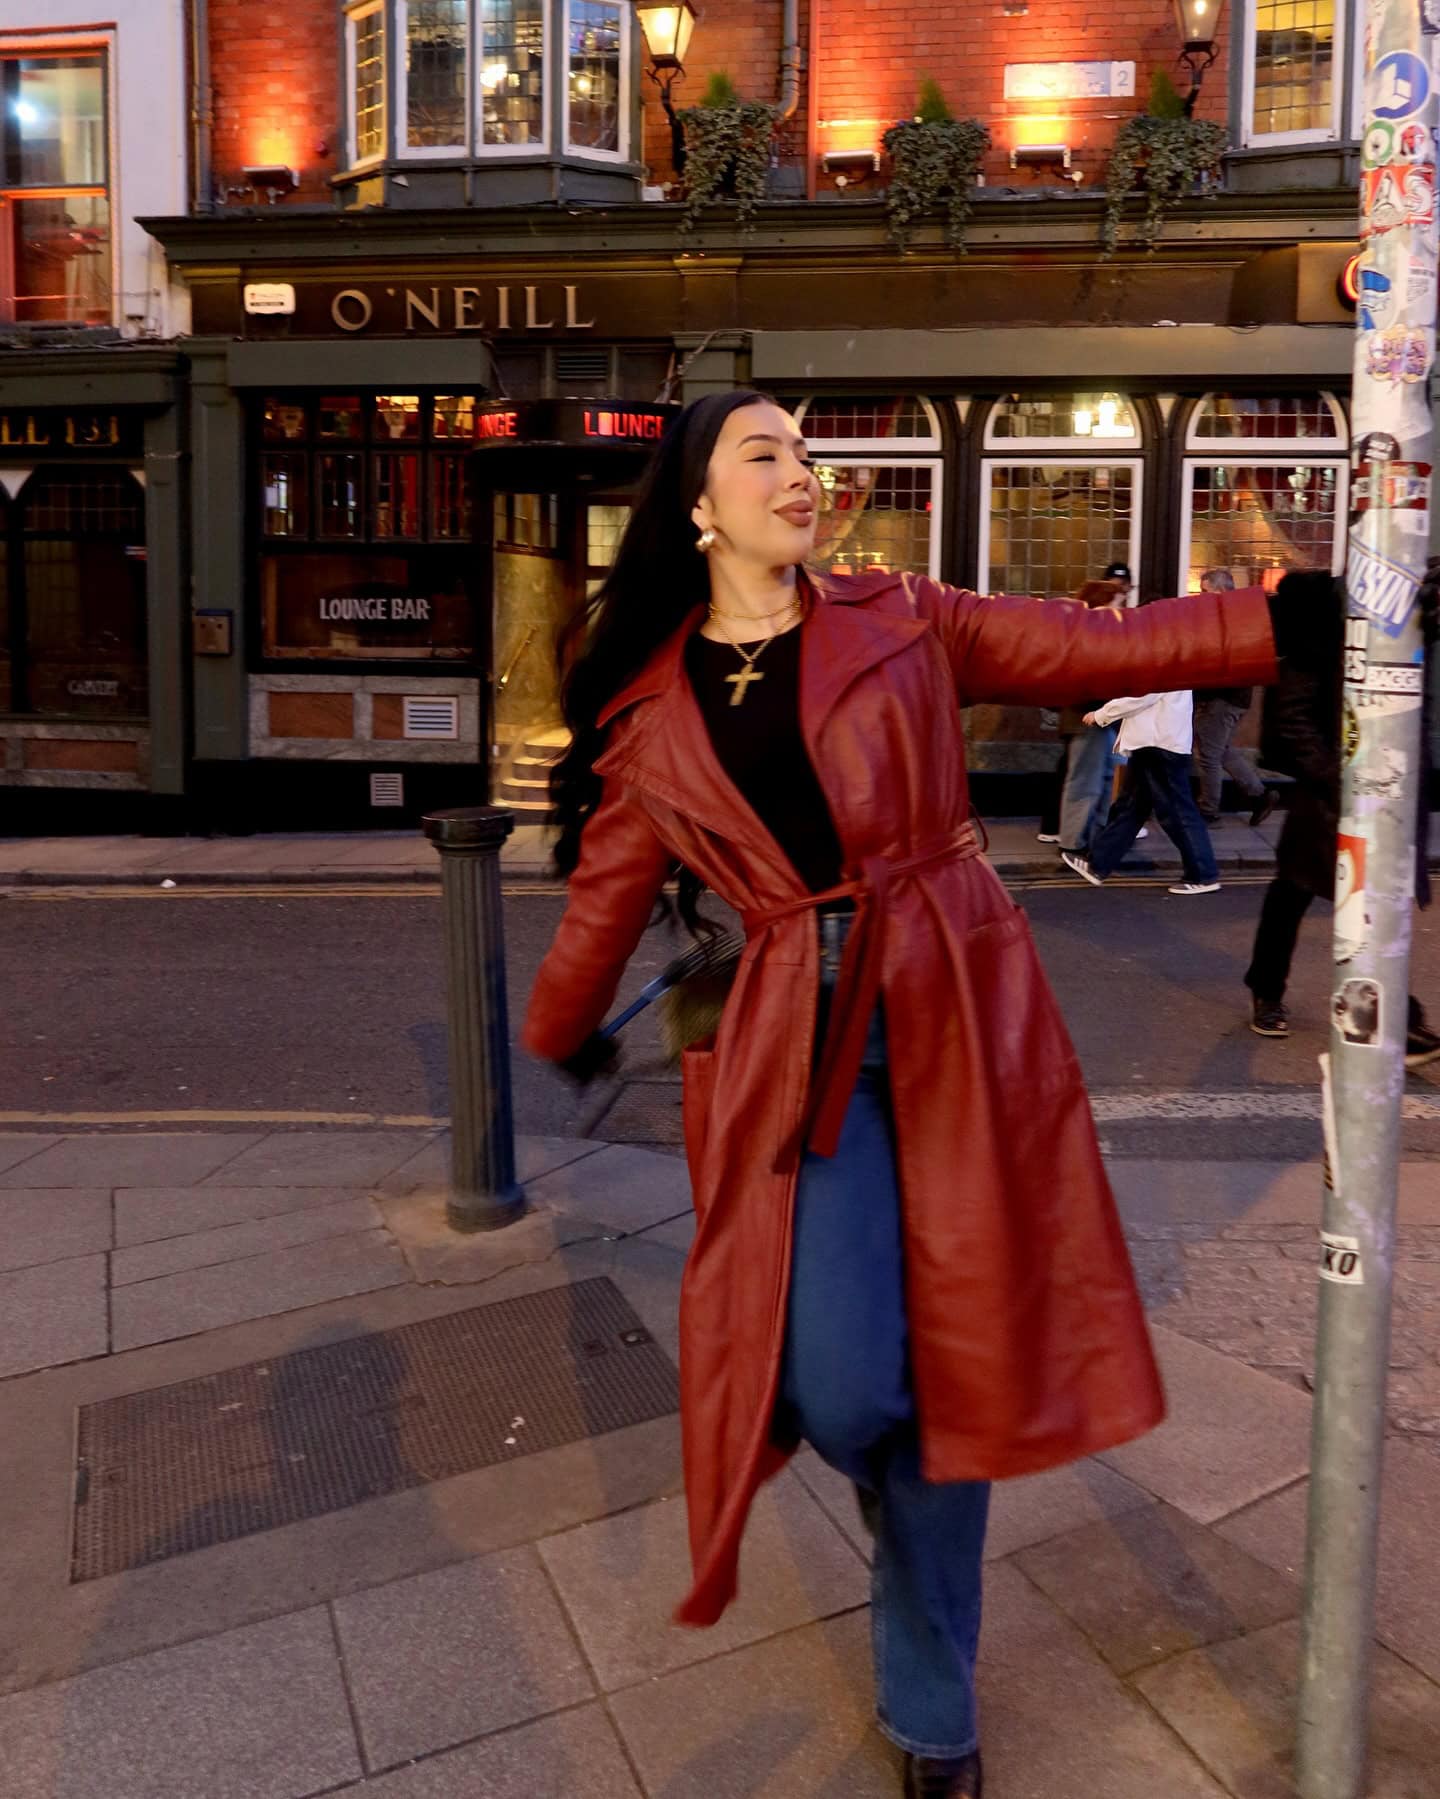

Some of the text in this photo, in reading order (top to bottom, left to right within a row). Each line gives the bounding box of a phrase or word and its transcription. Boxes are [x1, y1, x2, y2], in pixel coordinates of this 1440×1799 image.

[1117, 70, 1129, 87] 2
[331, 285, 596, 331] O'NEILL
[319, 597, 430, 620] LOUNGE BAR
